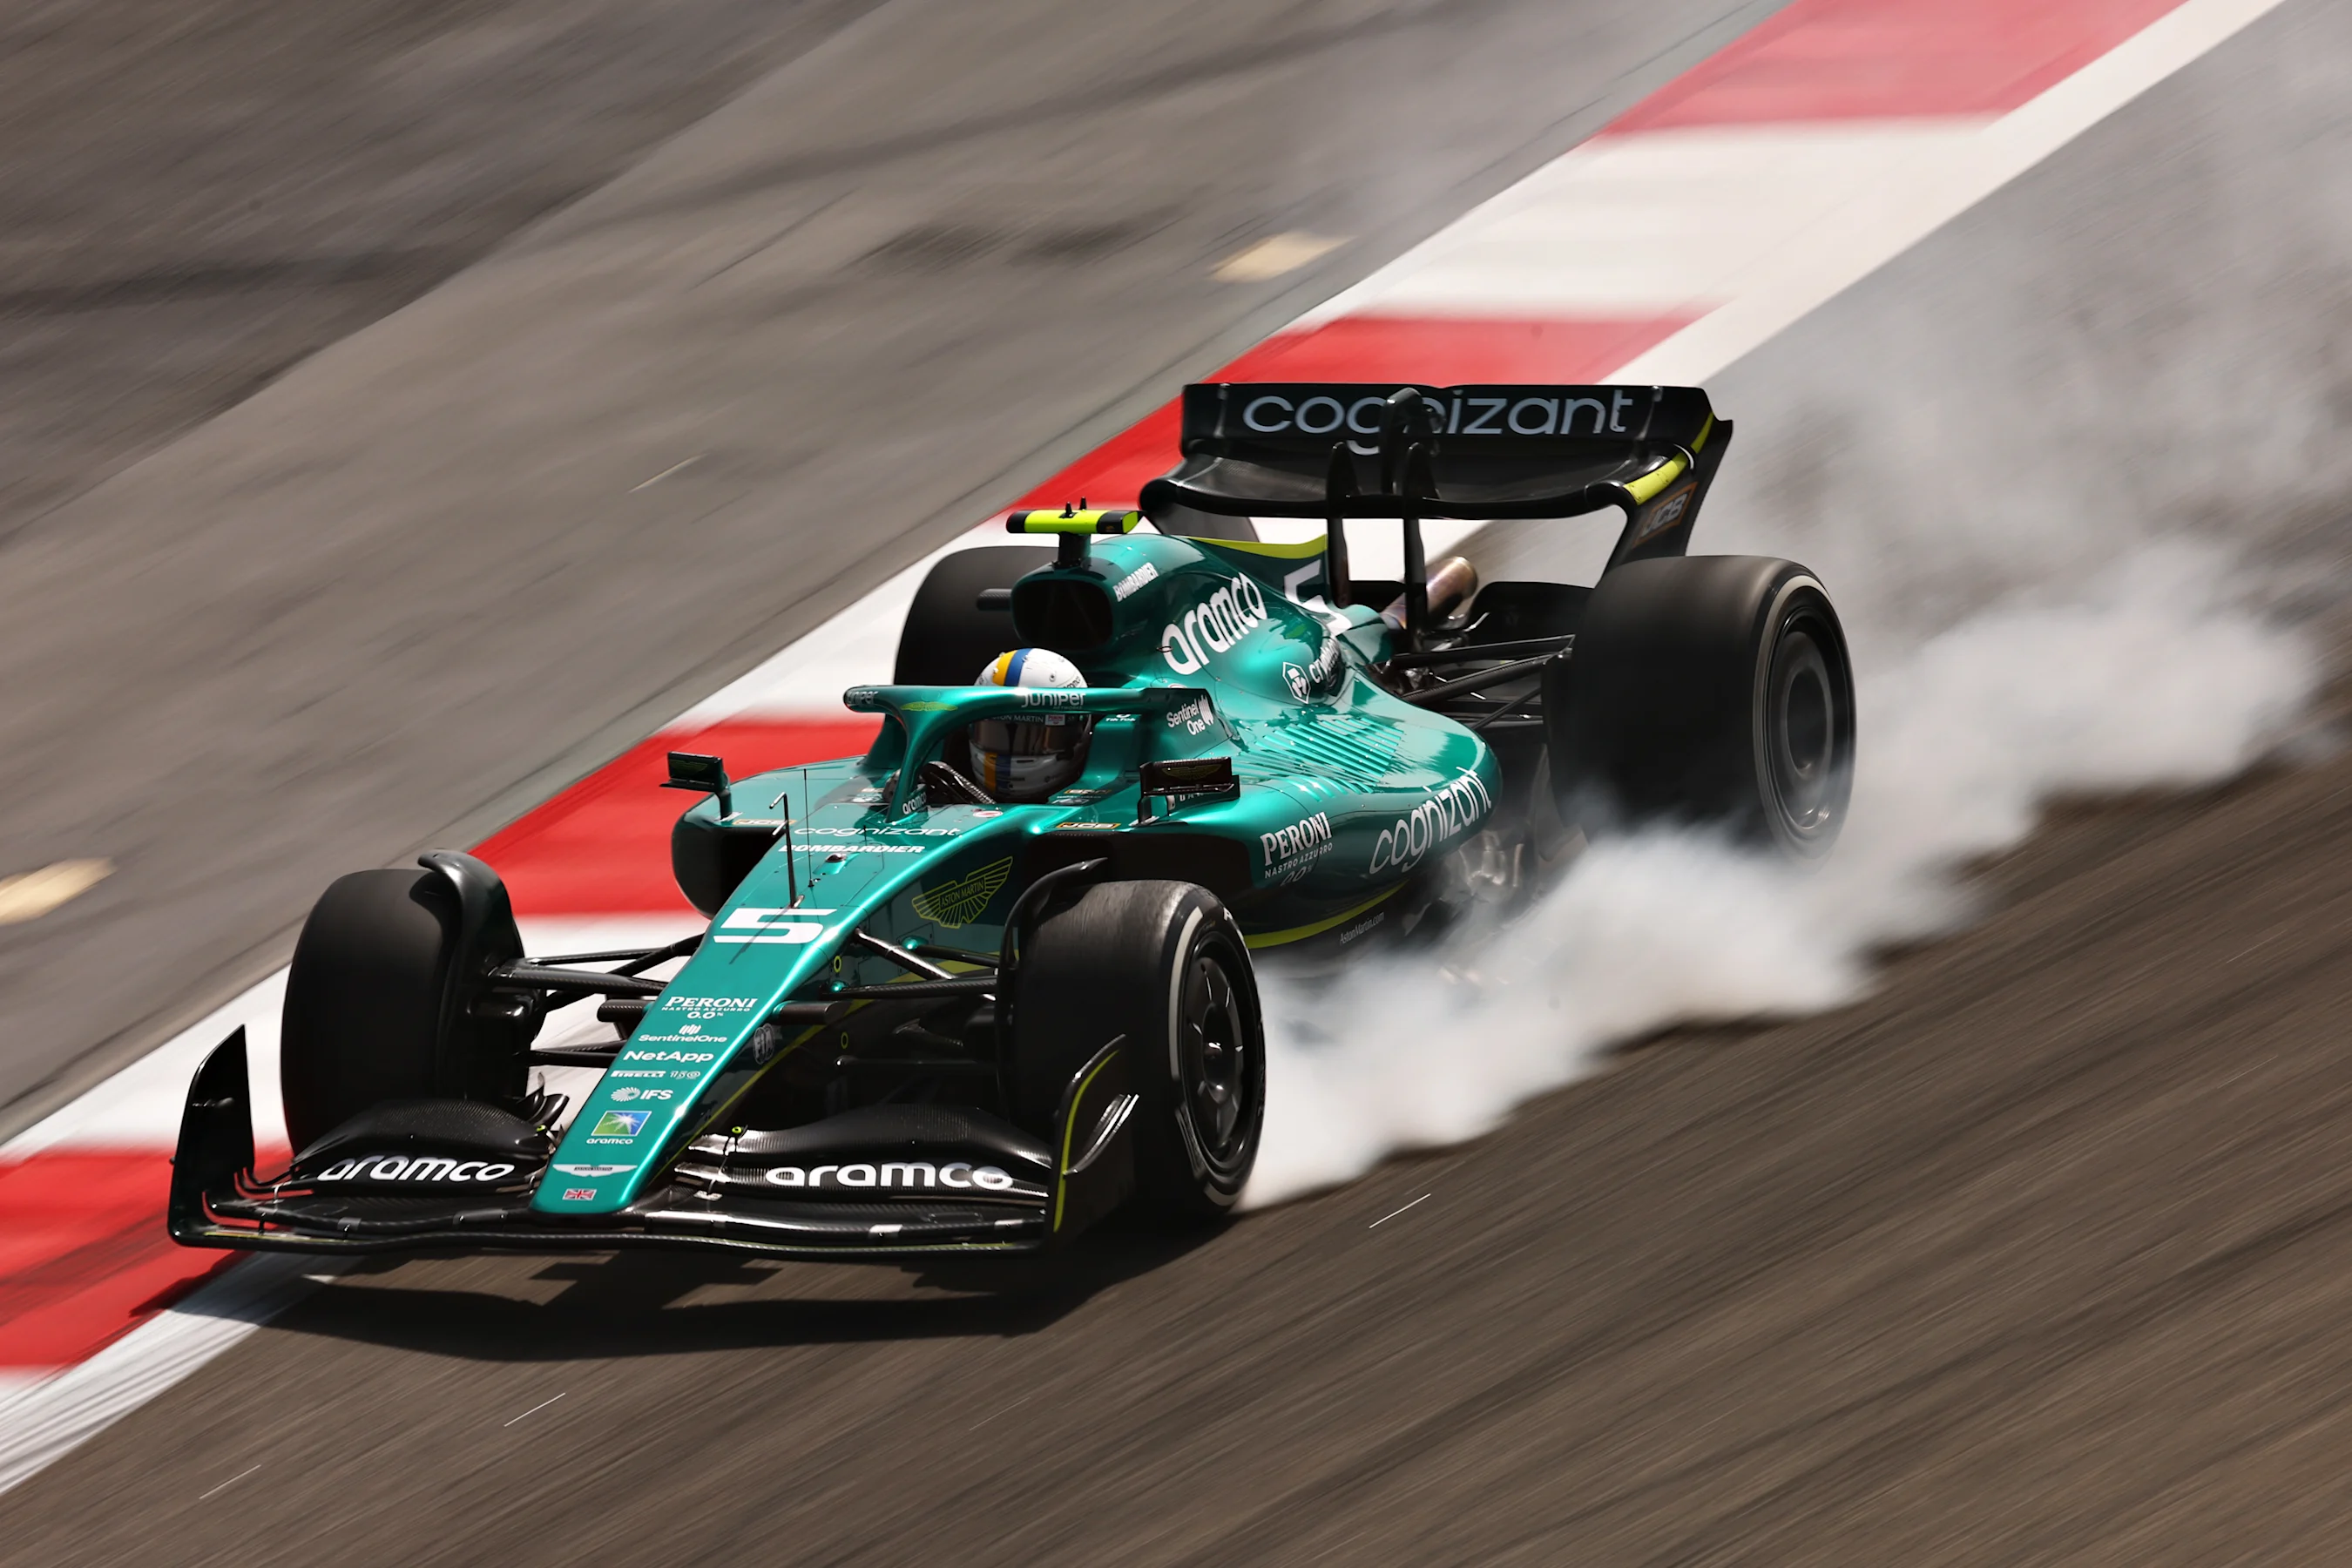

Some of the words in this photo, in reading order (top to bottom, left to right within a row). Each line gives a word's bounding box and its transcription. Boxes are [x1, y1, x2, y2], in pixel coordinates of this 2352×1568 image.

[1161, 571, 1267, 674] aramco
[1013, 714, 1044, 724] MARTIN
[1166, 698, 1200, 728] Sentinel
[1186, 719, 1206, 735] One
[902, 792, 927, 815] aramco
[794, 826, 960, 837] cognizant
[1369, 766, 1491, 875] cognizant
[1260, 811, 1332, 866] PERONI
[1265, 858, 1298, 879] NASTRO
[1299, 842, 1333, 864] AZZURRO
[941, 892, 961, 906] ASTON
[962, 879, 984, 899] MARTIN
[713, 908, 837, 943] 5
[665, 997, 759, 1008] PERONI
[639, 1034, 728, 1043] SentinelOne
[623, 1051, 714, 1064] NetApp
[611, 1070, 666, 1078] PIRELLI
[640, 1089, 674, 1100] IFS
[316, 1155, 516, 1182] aramco
[765, 1161, 1014, 1191] aramco
